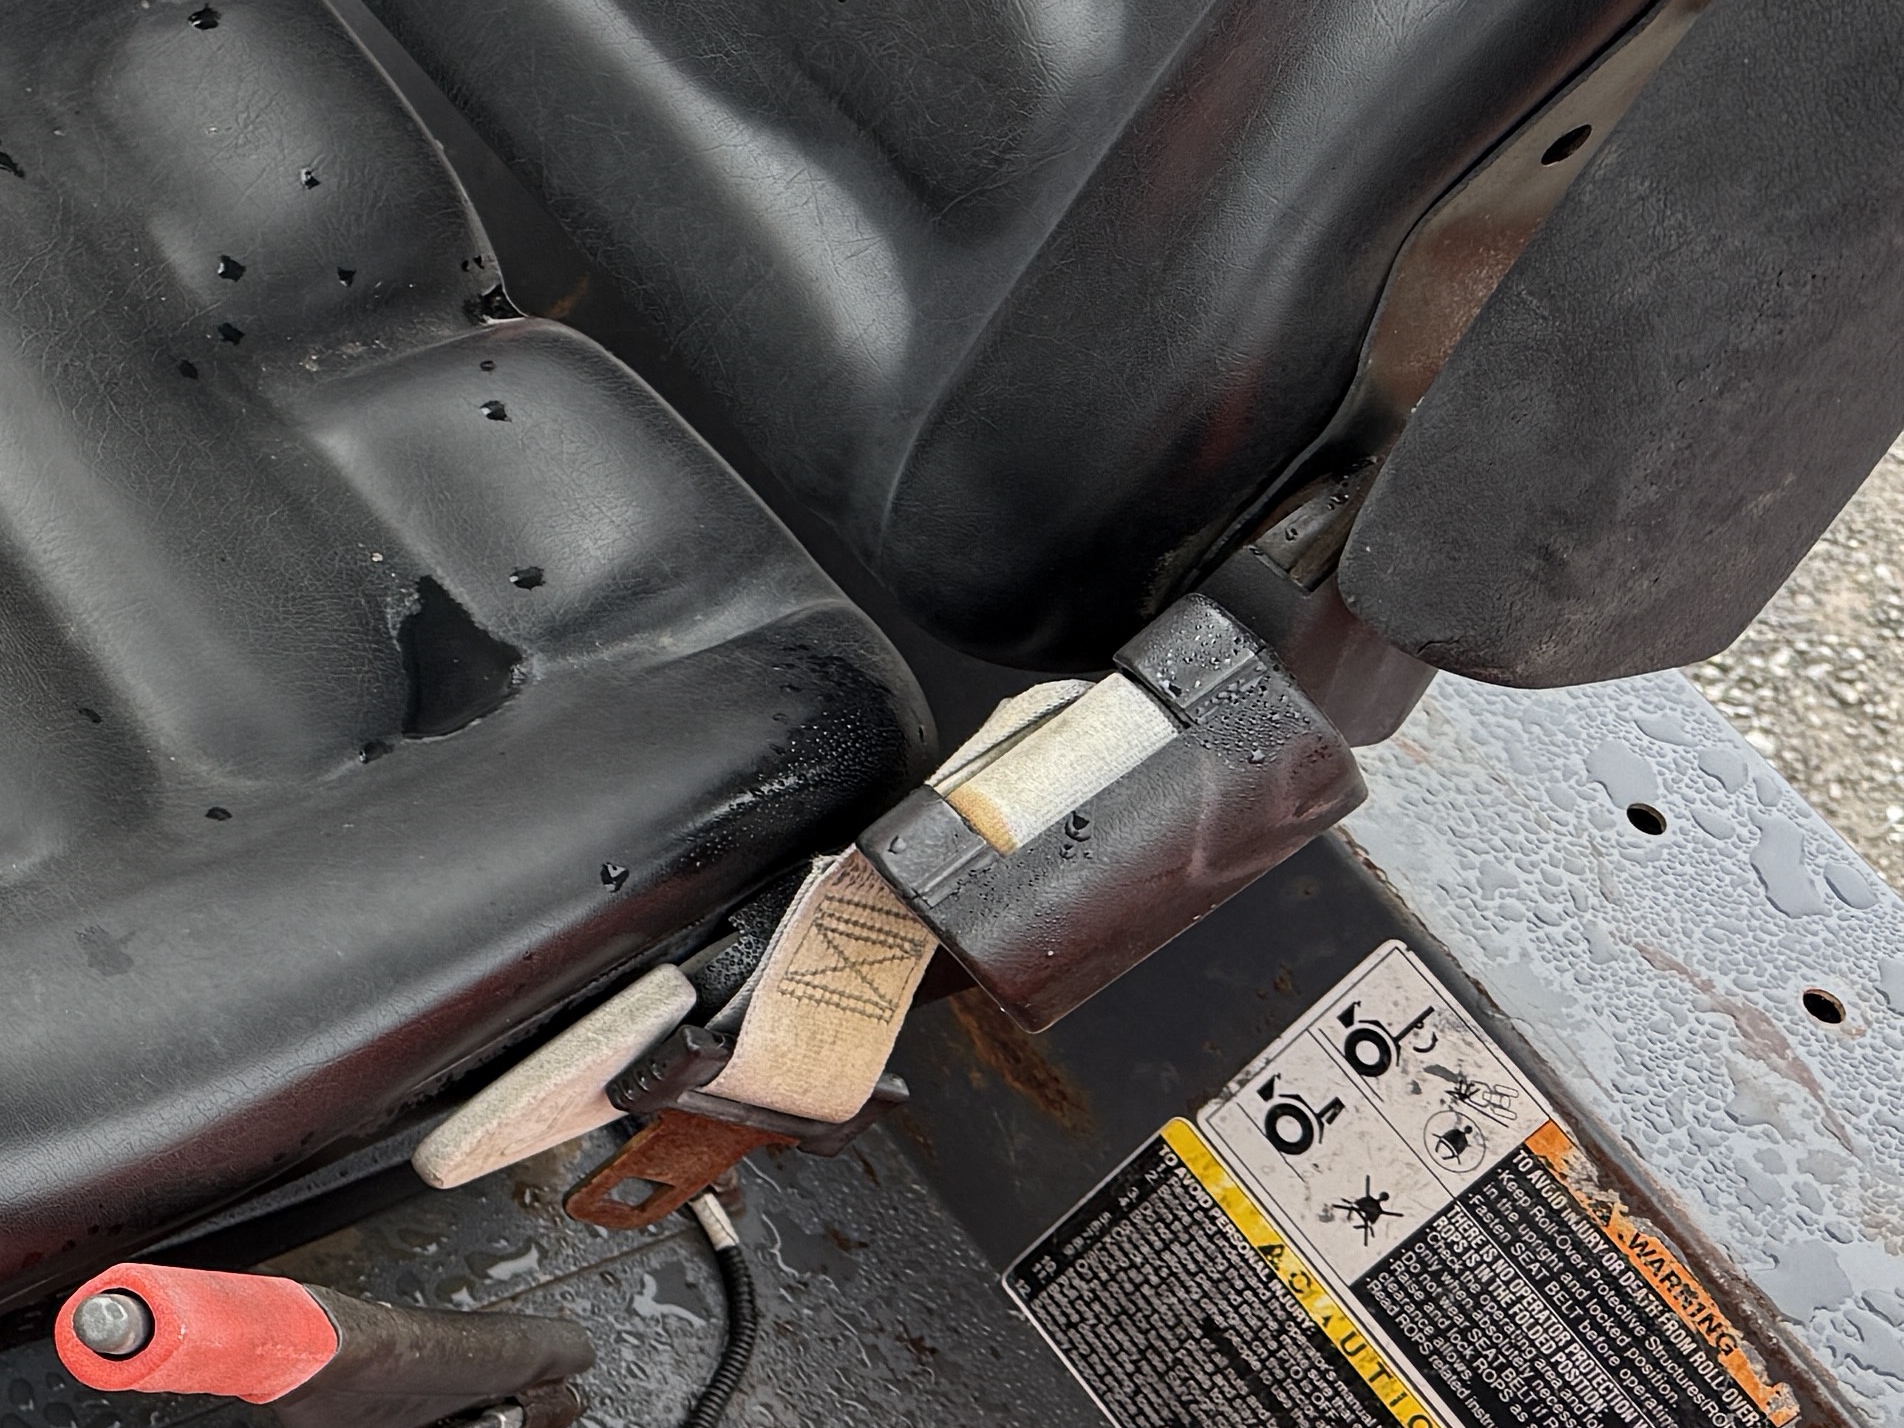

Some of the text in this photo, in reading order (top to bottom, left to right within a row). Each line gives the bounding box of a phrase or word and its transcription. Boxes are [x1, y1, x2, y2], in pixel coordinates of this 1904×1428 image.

[1156, 1143, 1318, 1335] TO AVOID PERSONAL INJURY:
[1482, 1181, 1685, 1411] in the upright and locked position.
[1509, 1240, 1548, 1283] SEAT
[1543, 1280, 1582, 1322] BELT
[1577, 1319, 1622, 1368] before
[1510, 1148, 1535, 1173] TO
[1526, 1166, 1568, 1211] AVOID
[1600, 1250, 1626, 1276] OR
[1654, 1312, 1697, 1356] FROM
[1529, 1204, 1589, 1270] Roll-Over
[1584, 1267, 1649, 1338] Protective
[1624, 1231, 1740, 1357] WARNING
[1266, 1297, 1289, 1321] the
[1333, 1378, 1377, 1427] manual
[1277, 1331, 1312, 1370] make
[1306, 1367, 1333, 1397] sure
[1330, 1395, 1356, 1423] that
[1377, 1269, 1477, 1385] clearance allows.
[1394, 1313, 1433, 1356] ROPS
[1427, 1352, 1470, 1399] related
[1410, 1239, 1443, 1274] only
[1438, 1269, 1475, 1309] when
[1468, 1307, 1535, 1381] absolutely
[1418, 1271, 1443, 1297] not
[1437, 1295, 1469, 1330] wear
[1465, 1326, 1505, 1370] SEAT
[1500, 1367, 1538, 1408] BELT
[1531, 1403, 1547, 1419] if
[1422, 1299, 1451, 1329] and
[1446, 1327, 1476, 1360] lock
[1471, 1357, 1514, 1403] ROPS
[1509, 1402, 1528, 1423] as
[1432, 1215, 1610, 1419] ROPS IS IN THE FOLDED POSITION:
[1445, 1204, 1486, 1248] THERE
[1491, 1257, 1515, 1282] NO
[1507, 1277, 1571, 1346] OPERATOR
[1563, 1342, 1638, 1423] PROTECTION
[1459, 1269, 1483, 1294] the
[1475, 1291, 1539, 1361] operating
[1533, 1357, 1563, 1389] area
[1558, 1385, 1588, 1416] and
